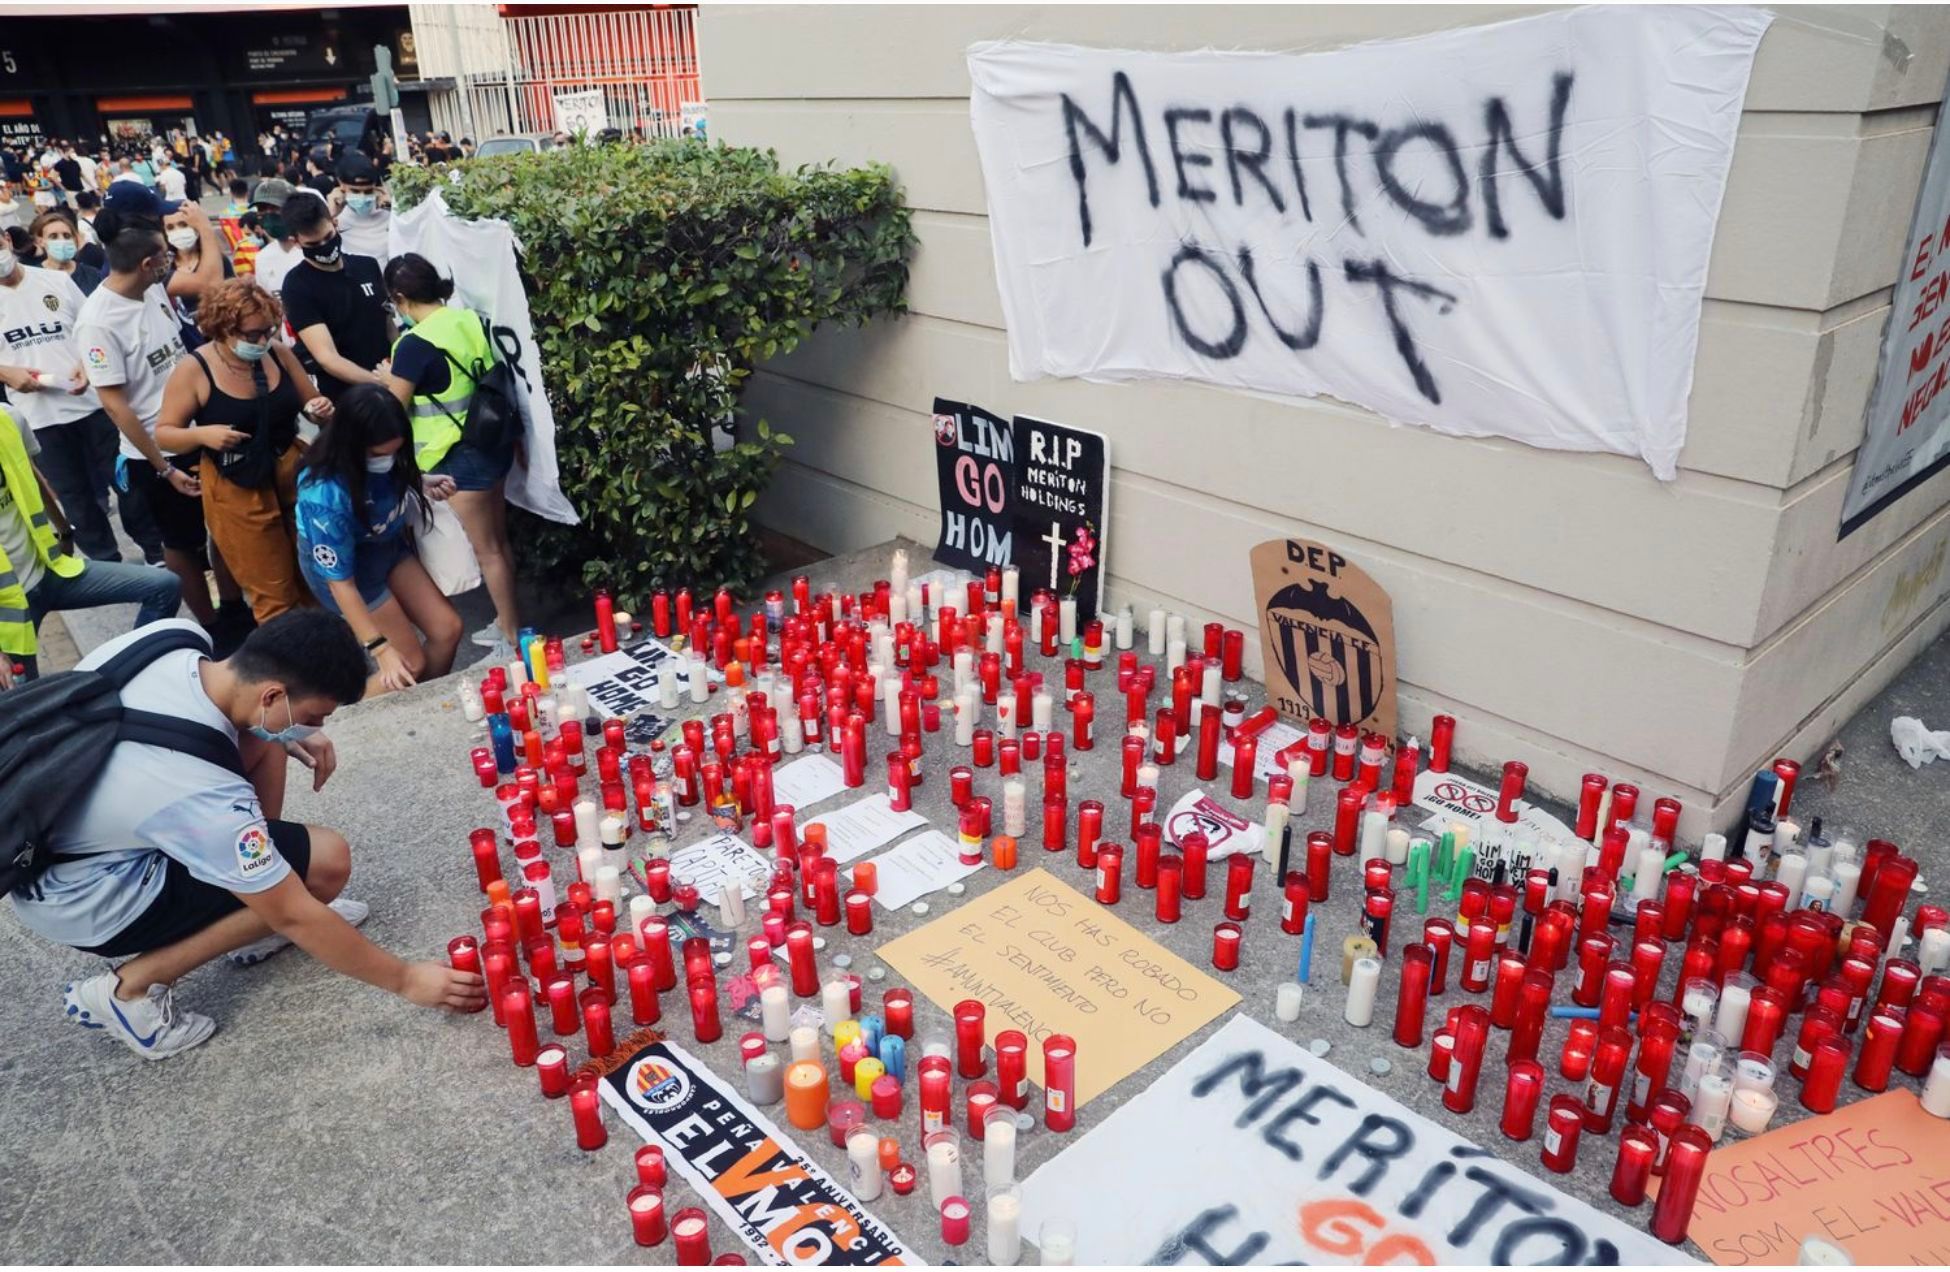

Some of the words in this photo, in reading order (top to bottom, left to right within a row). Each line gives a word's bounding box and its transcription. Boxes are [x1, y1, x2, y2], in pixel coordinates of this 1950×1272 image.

[2, 51, 17, 73] 5
[1059, 69, 1576, 247] MERITON
[1160, 240, 1459, 405] OUT
[955, 413, 1014, 463] LIM
[955, 455, 1005, 514] GO
[1021, 485, 1086, 516] HOLDINGS
[1272, 611, 1343, 642] VALENCIA
[586, 680, 651, 716] HOME
[613, 666, 659, 691] GO
[242, 855, 271, 872] LaLiga
[711, 836, 767, 875] PAREJO
[1479, 841, 1501, 858] LIM
[958, 923, 988, 945] EL
[996, 945, 1098, 1015] SENTIMIENTO
[990, 905, 1024, 929] EL
[1028, 929, 1077, 963] CLUB
[1083, 965, 1128, 1000] PERO
[1133, 998, 1171, 1026] NO
[1023, 884, 1075, 917] NOS
[1074, 918, 1119, 948] HAS
[1119, 949, 1199, 1003] ROBADO
[661, 1112, 735, 1180] EL
[702, 1099, 765, 1152] PEÑA
[1690, 1127, 1913, 1221] NOSALTRES
[738, 1222, 769, 1249] 1992
[815, 1175, 903, 1256] ANIVERSARIO
[1712, 1222, 1802, 1266] SOM
[1812, 1206, 1880, 1241] EL
